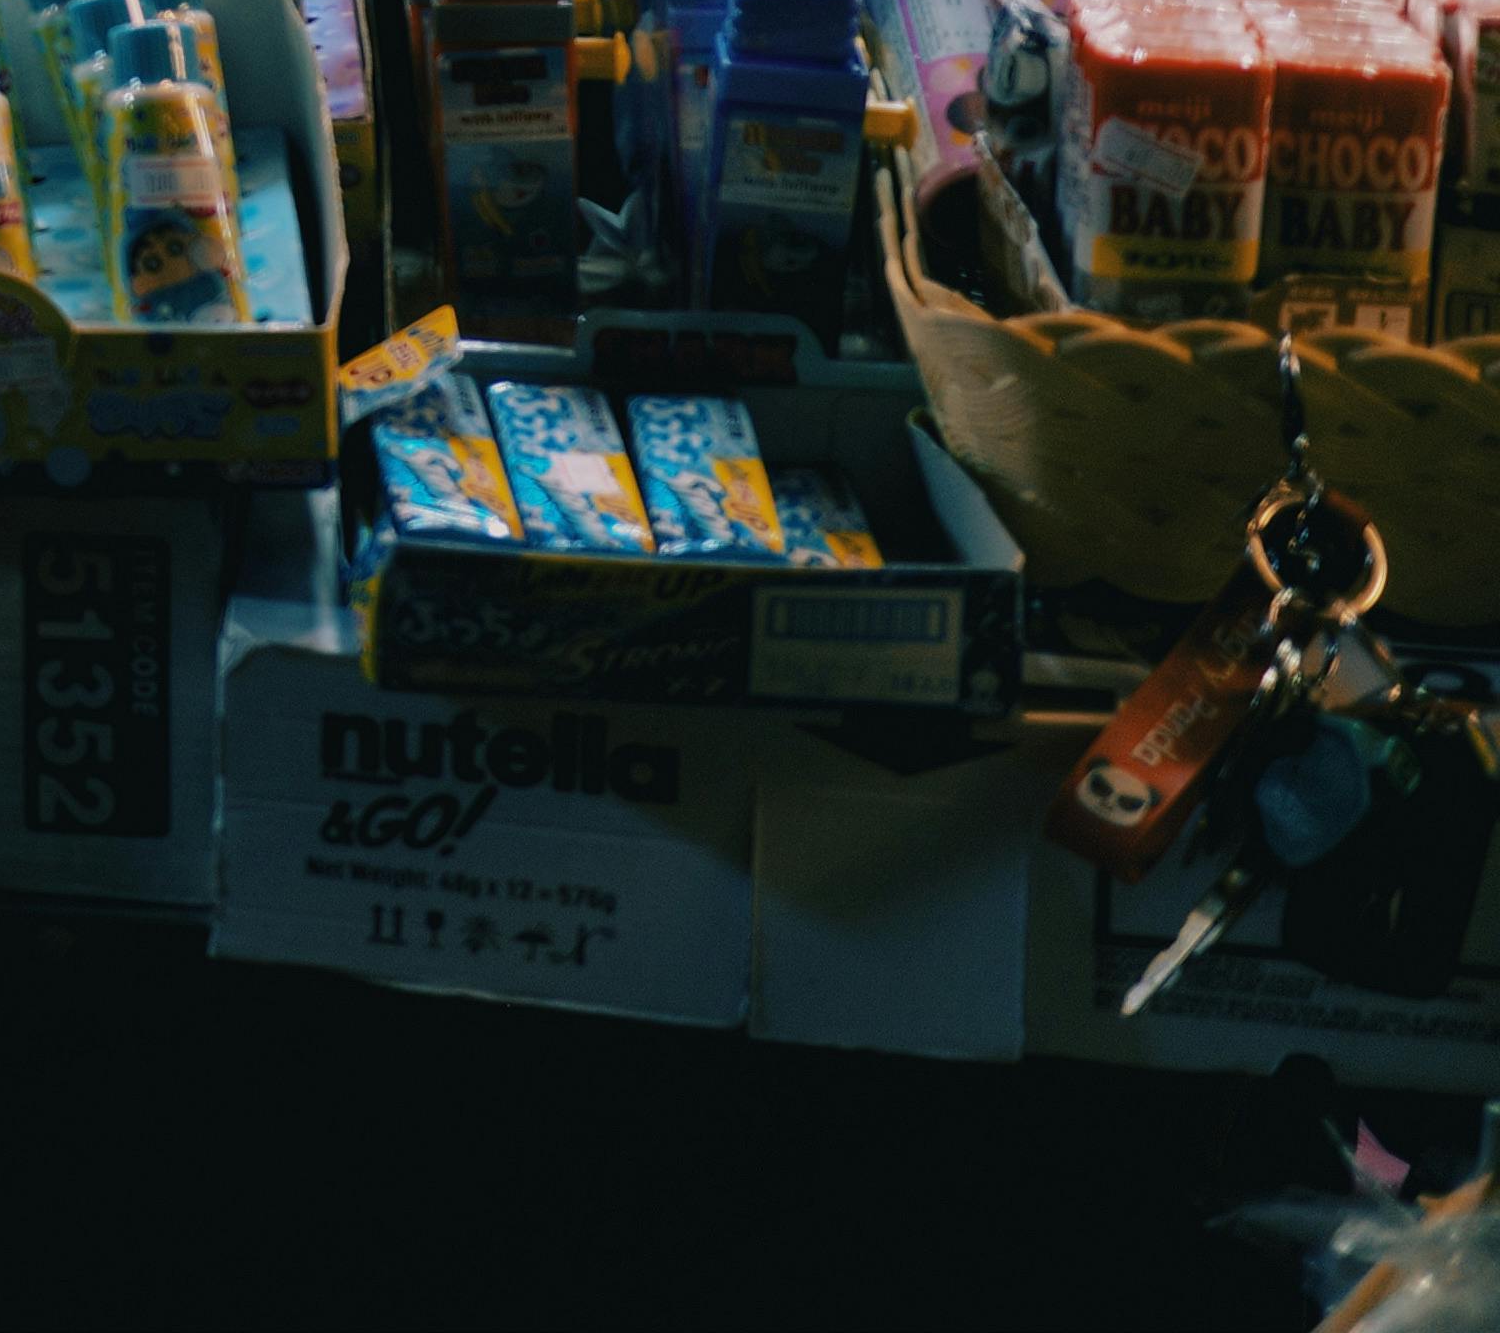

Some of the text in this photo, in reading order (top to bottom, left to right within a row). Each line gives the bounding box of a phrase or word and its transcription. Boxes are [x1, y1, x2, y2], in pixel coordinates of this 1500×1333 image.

[1134, 96, 1213, 127] meiji
[1307, 104, 1385, 134] meiji
[1275, 135, 1436, 195] CHOCO
[1107, 188, 1246, 242] BABY
[1277, 201, 1421, 253] BABY
[131, 550, 160, 720] ITEM CODE
[34, 547, 117, 829] 51352
[318, 709, 684, 809] nutella
[318, 790, 499, 855] &GO!
